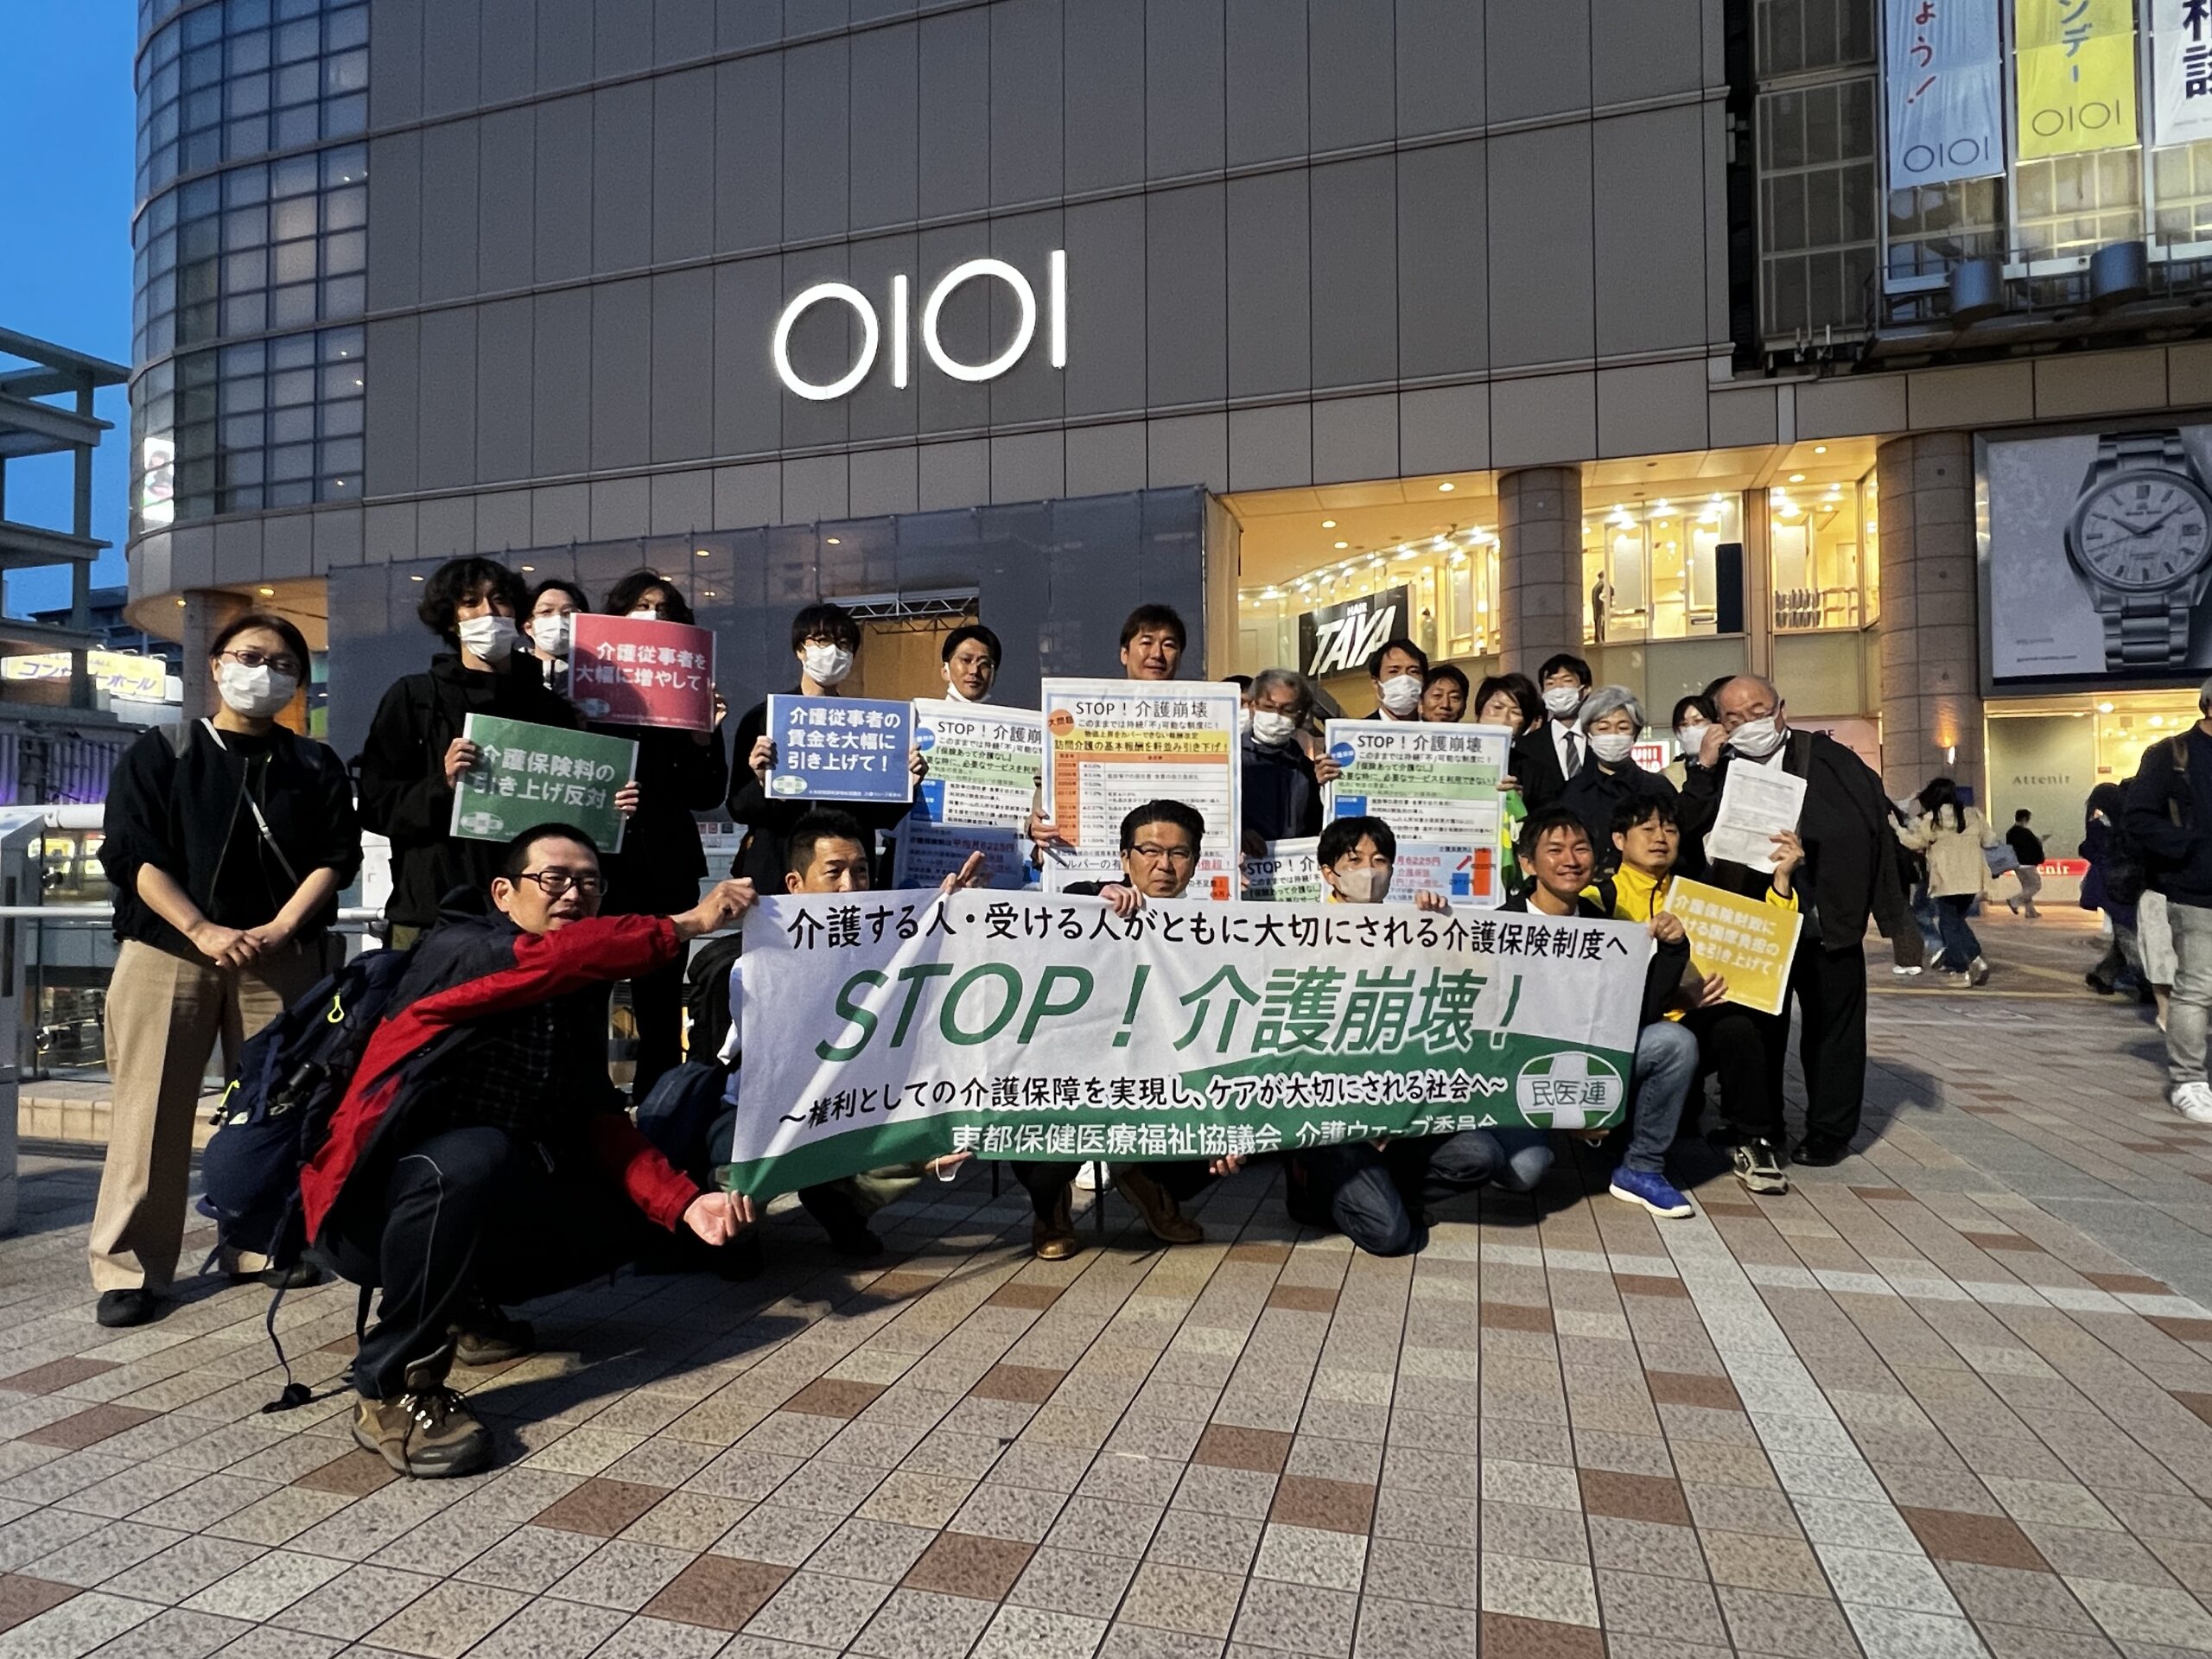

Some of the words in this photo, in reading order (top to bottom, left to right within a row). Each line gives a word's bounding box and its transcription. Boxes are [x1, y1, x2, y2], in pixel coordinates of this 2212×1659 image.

[1308, 605, 1396, 677] TAYA
[596, 641, 707, 671] 介護従事者を
[790, 707, 901, 728] 介護従事者の
[787, 729, 896, 751] 賃金を大幅に
[483, 744, 615, 783] 介護保険料の
[788, 751, 887, 772] 引き上げて！
[2012, 773, 2071, 785] Attenir
[2037, 862, 2070, 875] enir
[787, 901, 1628, 960] 介護する人・受ける人がともに大切にされる介護保険制度へ
[1532, 1079, 1606, 1107] 民医連
[952, 1122, 1281, 1156] 東都保健医療福祉協議会
